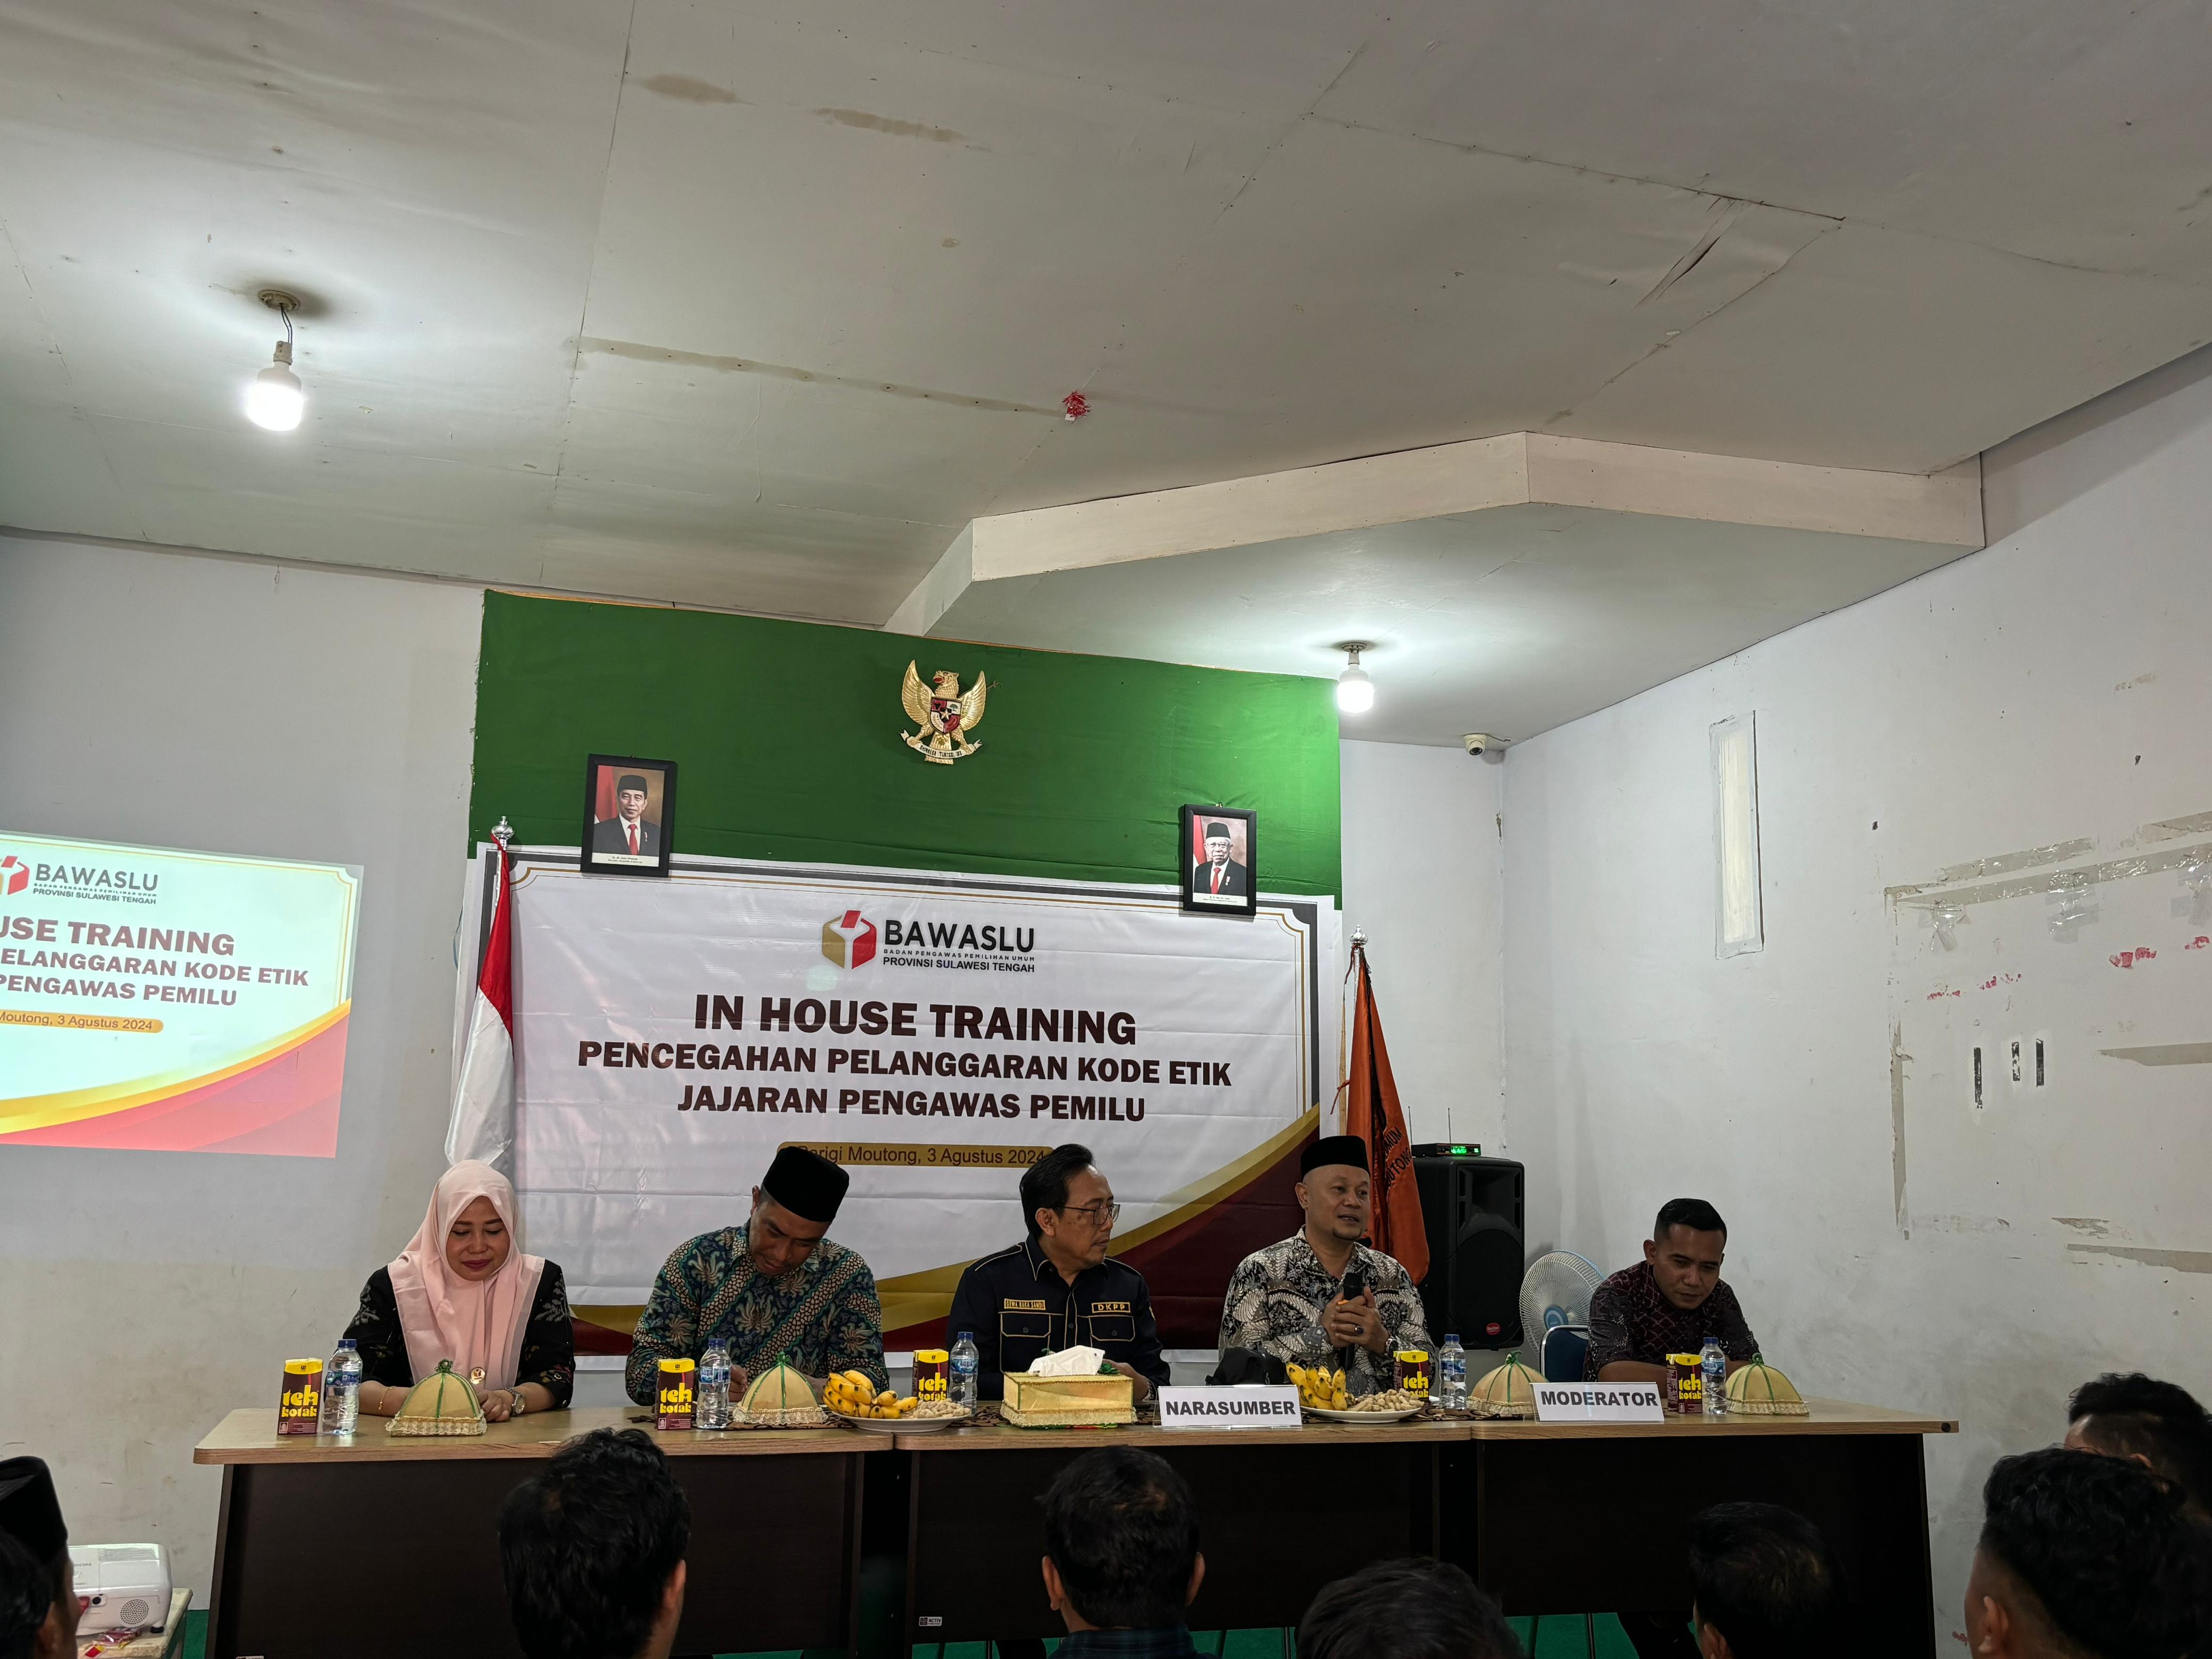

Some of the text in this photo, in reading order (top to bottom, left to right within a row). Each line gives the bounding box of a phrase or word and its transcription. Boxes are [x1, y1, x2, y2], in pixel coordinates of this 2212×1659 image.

[35, 863, 158, 891] BAWASLU
[32, 888, 156, 905] PROVINSI SULAWESI TENGAH
[68, 921, 234, 956] TRAINING
[885, 920, 1034, 952] BAWASLU
[185, 961, 252, 983] KODE
[258, 968, 308, 986] ETIK
[883, 957, 1034, 973] PROVINSI SULAWESI TENGAH
[143, 984, 237, 1006] PEMILU
[57, 1015, 65, 1025] 3
[68, 1016, 119, 1030] Agustus
[122, 1019, 153, 1030] 2024
[695, 994, 1136, 1044] IN HOUSE TRAINING
[579, 1041, 1231, 1086] PENCEGAHAN PELANGGARAN KODE ETIK
[678, 1085, 1145, 1121] JAJARAN PENGAWAS PEMILU
[848, 1146, 921, 1164] Moutong,
[927, 1149, 936, 1162] 3
[940, 1149, 1003, 1167] Agustus
[918, 1372, 947, 1392] teh
[1403, 1371, 1429, 1389] teh
[1678, 1373, 1702, 1391] teh
[283, 1385, 319, 1406] teh
[660, 1382, 692, 1403] teh
[1541, 1391, 1658, 1406] MODERATOR
[1679, 1390, 1702, 1400] kotak
[281, 1406, 317, 1418] kotak
[659, 1403, 691, 1414] kotak
[1166, 1401, 1296, 1415] NARASUMBER
